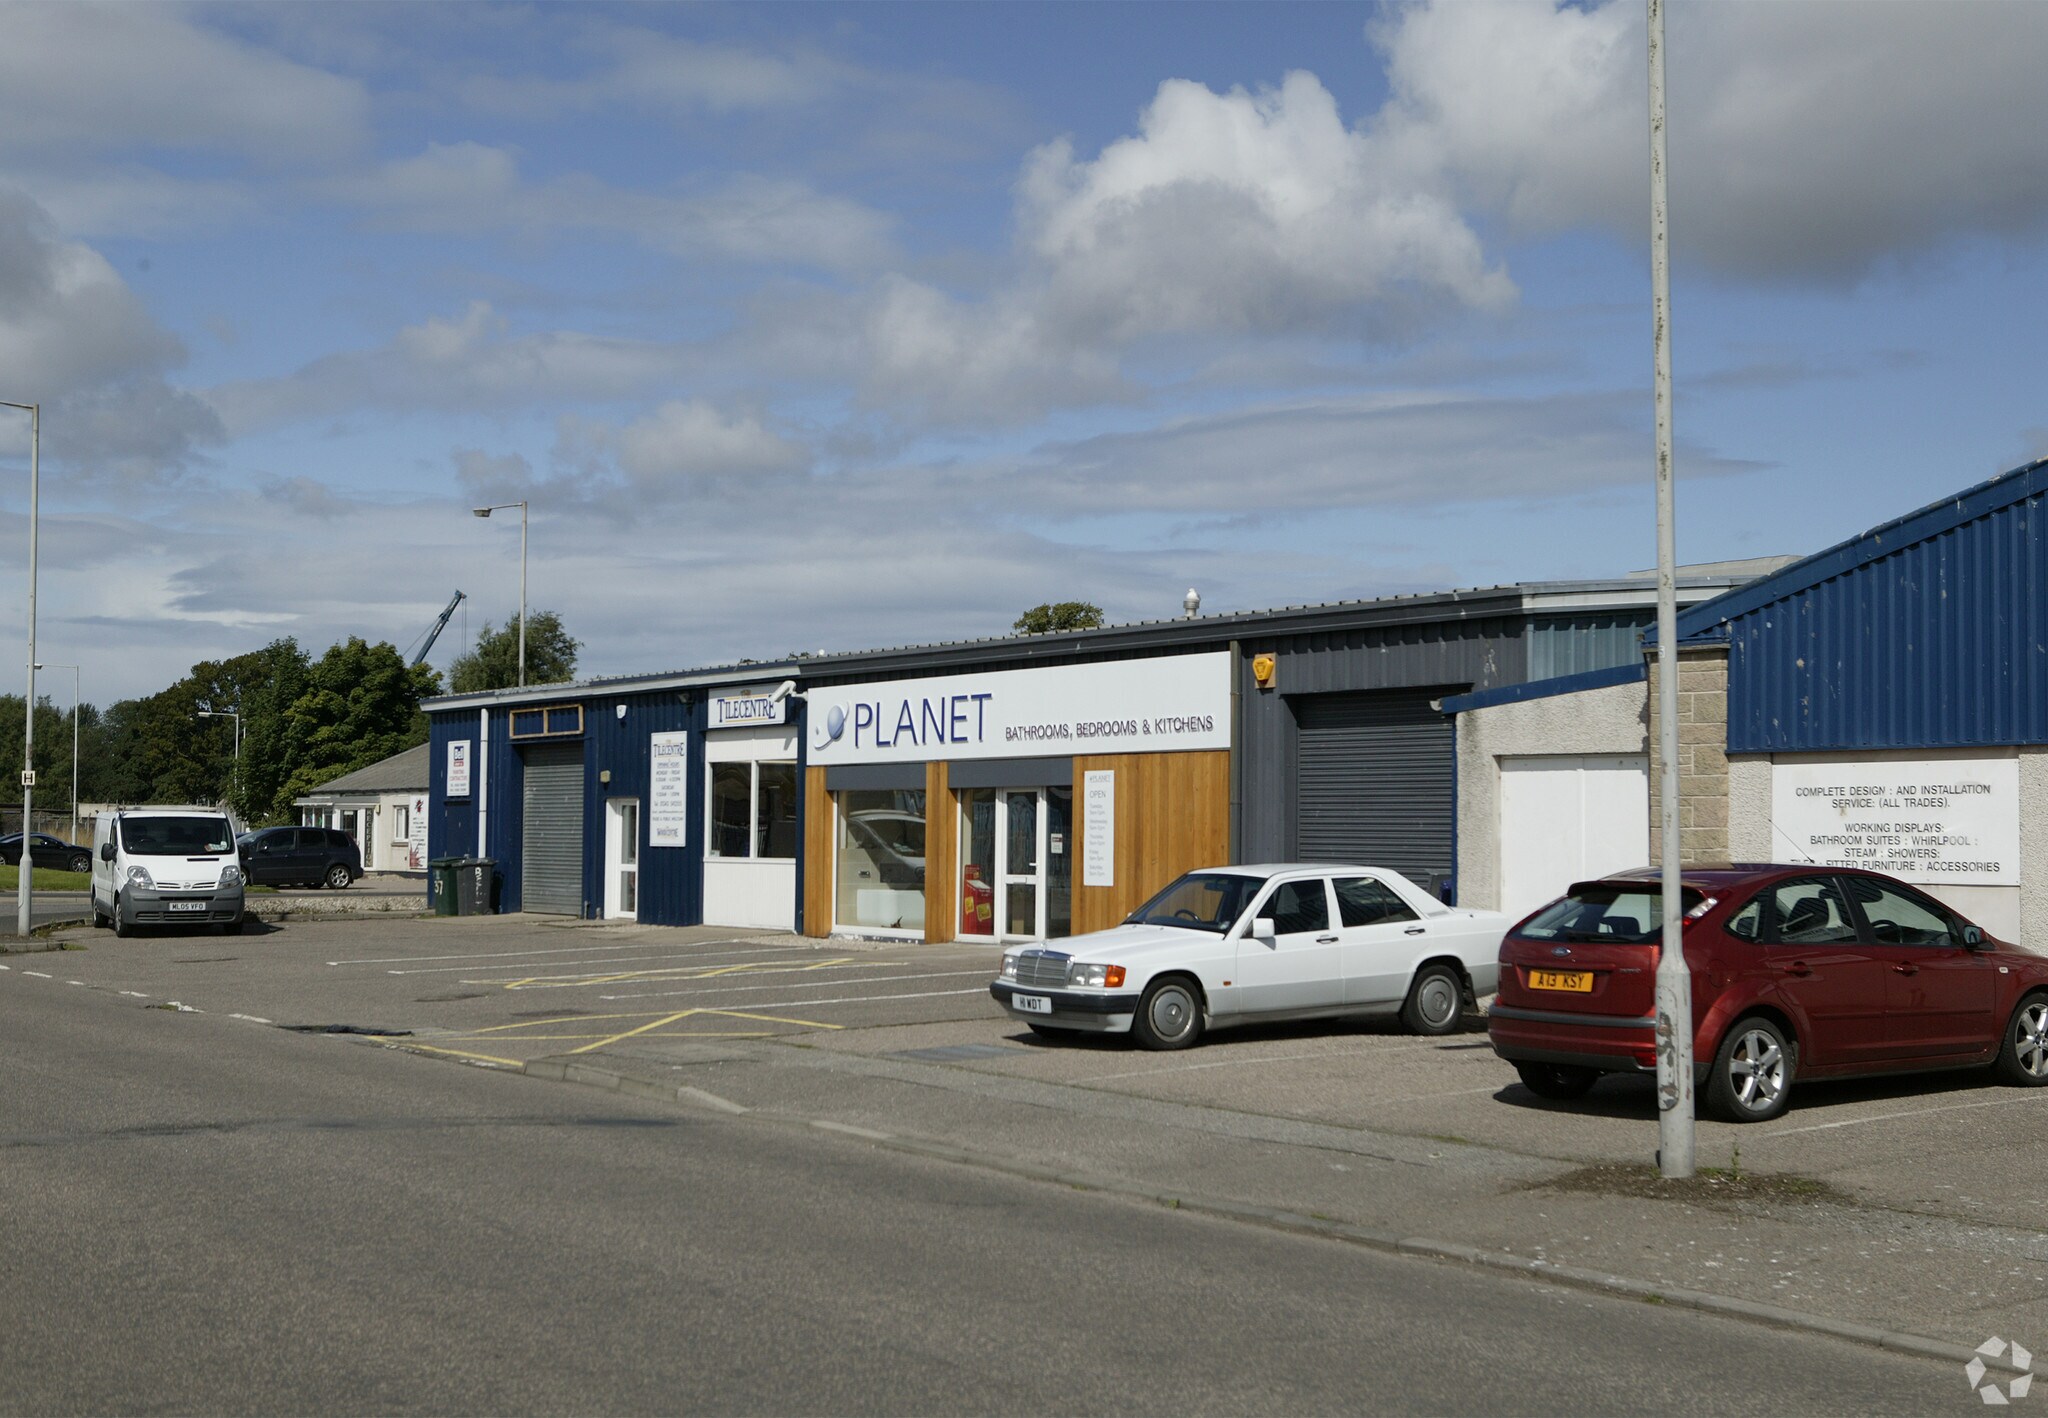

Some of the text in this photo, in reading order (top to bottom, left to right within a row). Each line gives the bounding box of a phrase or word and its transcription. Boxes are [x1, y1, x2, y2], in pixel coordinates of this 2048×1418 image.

[717, 694, 776, 723] TILECENTRE
[855, 693, 993, 749] PLANET
[1005, 715, 1214, 741] BATHROOMS, BEDROOMS & KITCHENS
[24, 773, 33, 783] H
[1089, 790, 1106, 799] OPEN
[1795, 786, 1846, 797] COMPLETE
[1849, 786, 1886, 796] DESIGN
[1896, 785, 1917, 795] AND
[1920, 784, 1991, 795] INSTALLATION
[1831, 797, 1951, 809] SERVICE: (ALL TRADES).
[1845, 822, 1945, 833] WORKING DISPLAYS:
[1810, 835, 1862, 845] BATHROOM
[1866, 835, 1901, 846] SUITES
[1911, 835, 1971, 846] WHIRLPOOL
[1844, 847, 1877, 858] STEAM
[1887, 848, 1941, 858] SHOWERS:
[1826, 859, 1859, 868] FITTED
[1862, 860, 1916, 871] FURNITURE
[1926, 861, 2001, 872] ACCESSORIES
[434, 880, 444, 895] 37
[1537, 972, 1585, 989] A13 KSY
